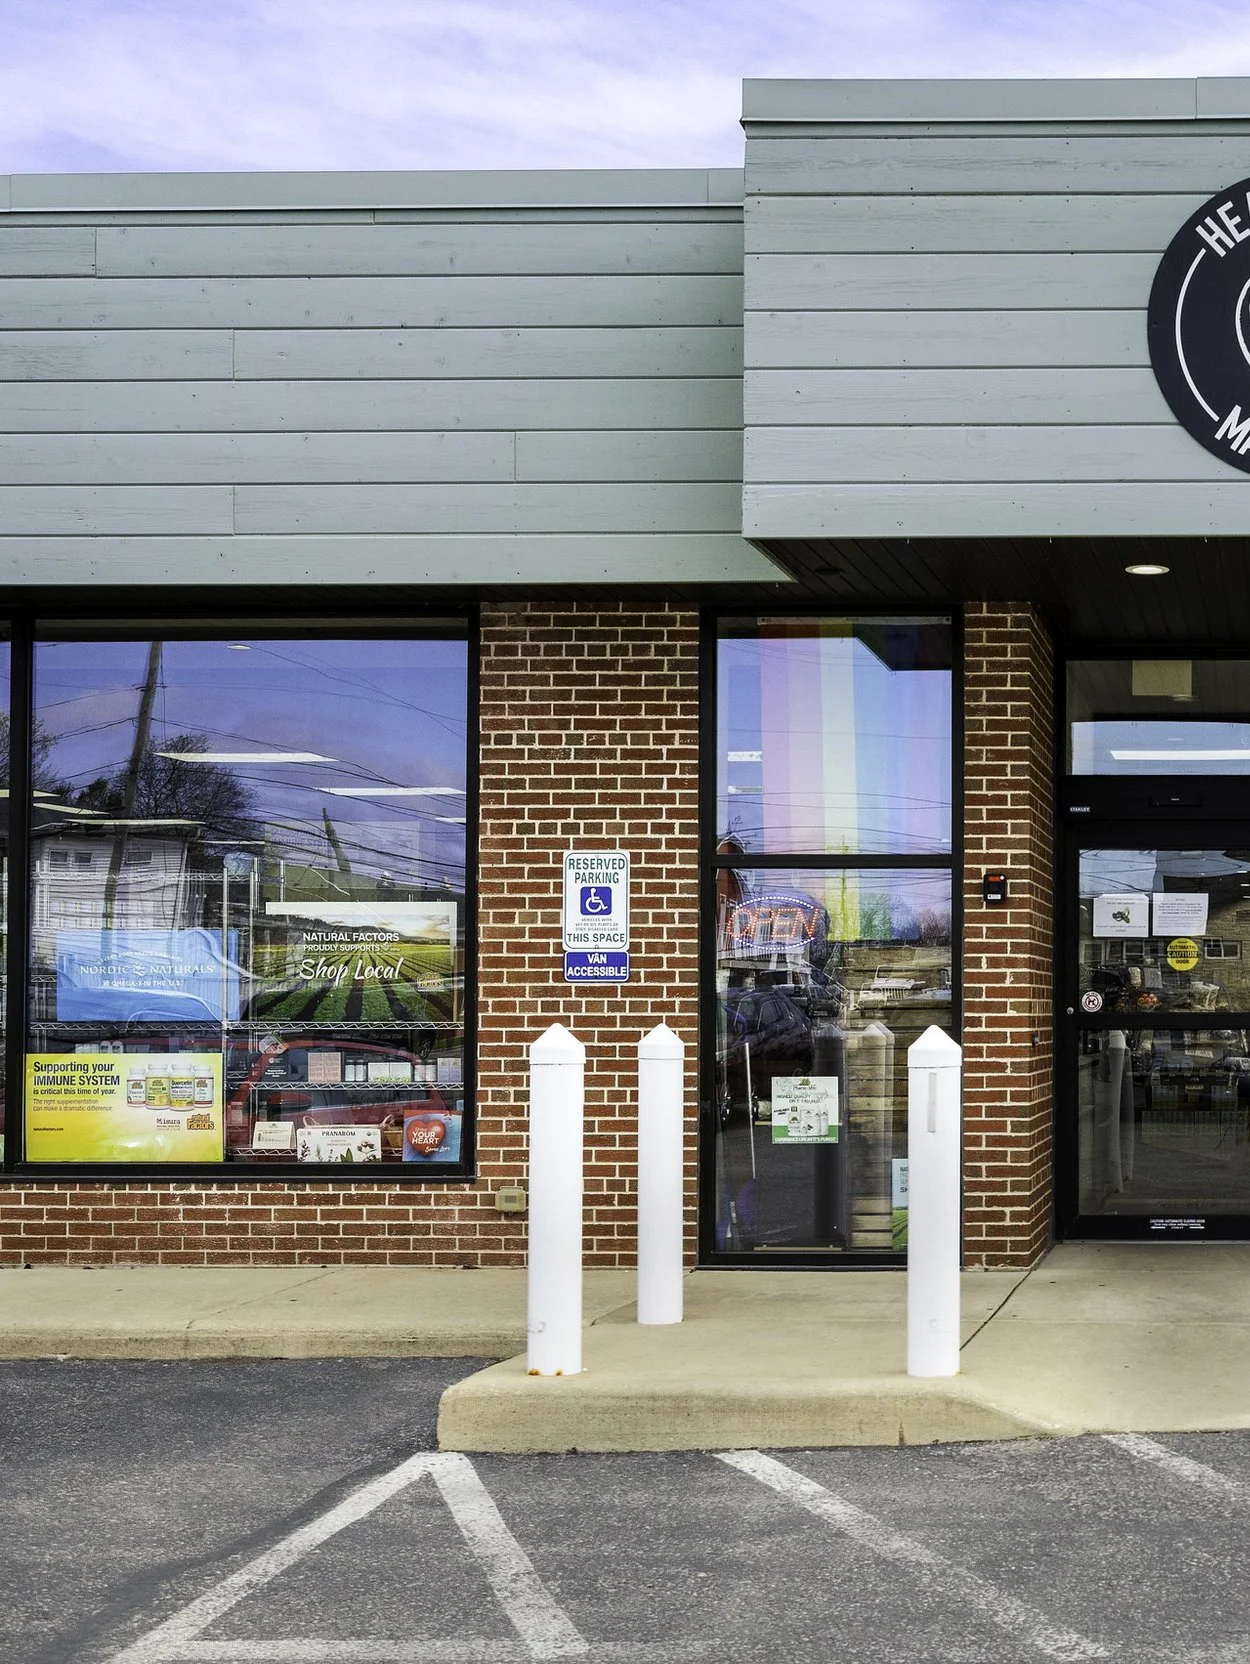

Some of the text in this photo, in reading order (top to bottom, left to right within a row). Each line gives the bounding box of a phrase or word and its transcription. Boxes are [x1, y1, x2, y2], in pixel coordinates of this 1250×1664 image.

[568, 858, 626, 870] RESERVED
[574, 872, 620, 884] PARKING
[726, 907, 820, 938] OPEN
[303, 933, 400, 941] NATURAL FACTORS
[567, 933, 625, 942] THIS SPACE
[587, 954, 607, 964] VAN
[79, 965, 131, 974] NORDIC
[299, 957, 404, 987] Shop Local
[567, 966, 627, 977] ACCESSIBLE
[33, 1061, 115, 1074] Supporting your
[33, 1075, 76, 1086] IMMUNE
[79, 1075, 120, 1086] SYSTEM
[187, 1119, 215, 1130] Factors
